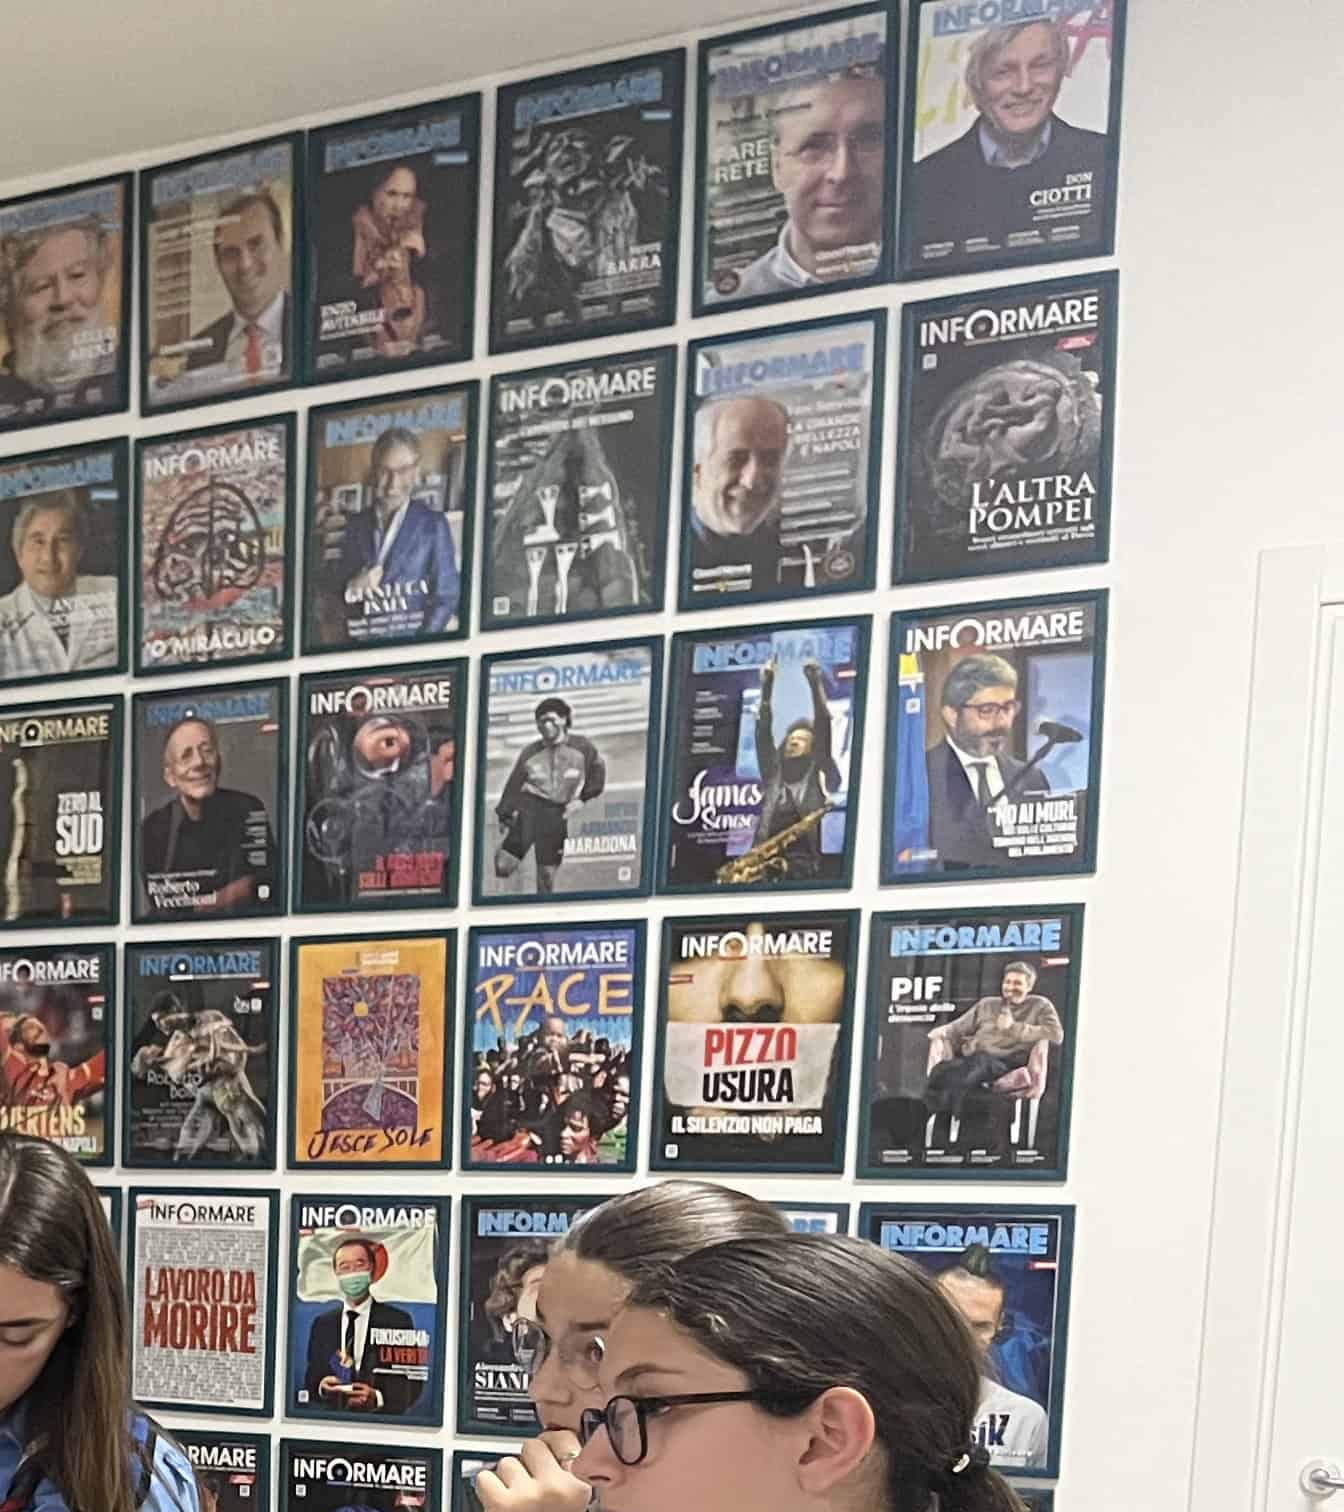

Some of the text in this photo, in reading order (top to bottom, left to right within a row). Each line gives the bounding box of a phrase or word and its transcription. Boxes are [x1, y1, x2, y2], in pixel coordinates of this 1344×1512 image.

[1030, 184, 1092, 206] CIOTTI
[921, 297, 1099, 347] INFORMARE
[500, 367, 656, 413] INFORMARE
[145, 437, 280, 478] INFORMARE
[972, 472, 1096, 508] L'ALTRA
[969, 498, 1092, 534] POMPEI
[171, 626, 275, 655] MIRACULO
[906, 611, 1084, 653] INFORMARE
[692, 636, 855, 674] INFORMARE
[491, 661, 642, 692] INFORMARE
[310, 681, 451, 715] INFORMARE
[56, 812, 104, 856] SUD
[564, 834, 637, 856] MARADONA
[681, 930, 833, 960] INFORMARE
[891, 920, 1062, 956] INFORMARE
[140, 952, 261, 979] INFORMARE
[480, 941, 629, 968] INFORMARE
[474, 973, 634, 1032] RACE
[892, 976, 943, 1000] PIF
[704, 1028, 796, 1067] PIZZO
[702, 1067, 794, 1103] USURA
[672, 1116, 823, 1134] IL SILENZIO NON PAGA
[150, 1204, 255, 1226] INFORMARE
[302, 1204, 436, 1229] INFORMARE
[478, 1210, 578, 1237] INFORM
[881, 1223, 1049, 1256] INFORMARE
[145, 1267, 256, 1303] LAVORO DA
[143, 1303, 256, 1354] MORIRE
[380, 1346, 392, 1362] LA
[475, 1372, 529, 1391] SIANI
[188, 1446, 256, 1468] RMARE
[293, 1457, 427, 1487] INFORMARE
